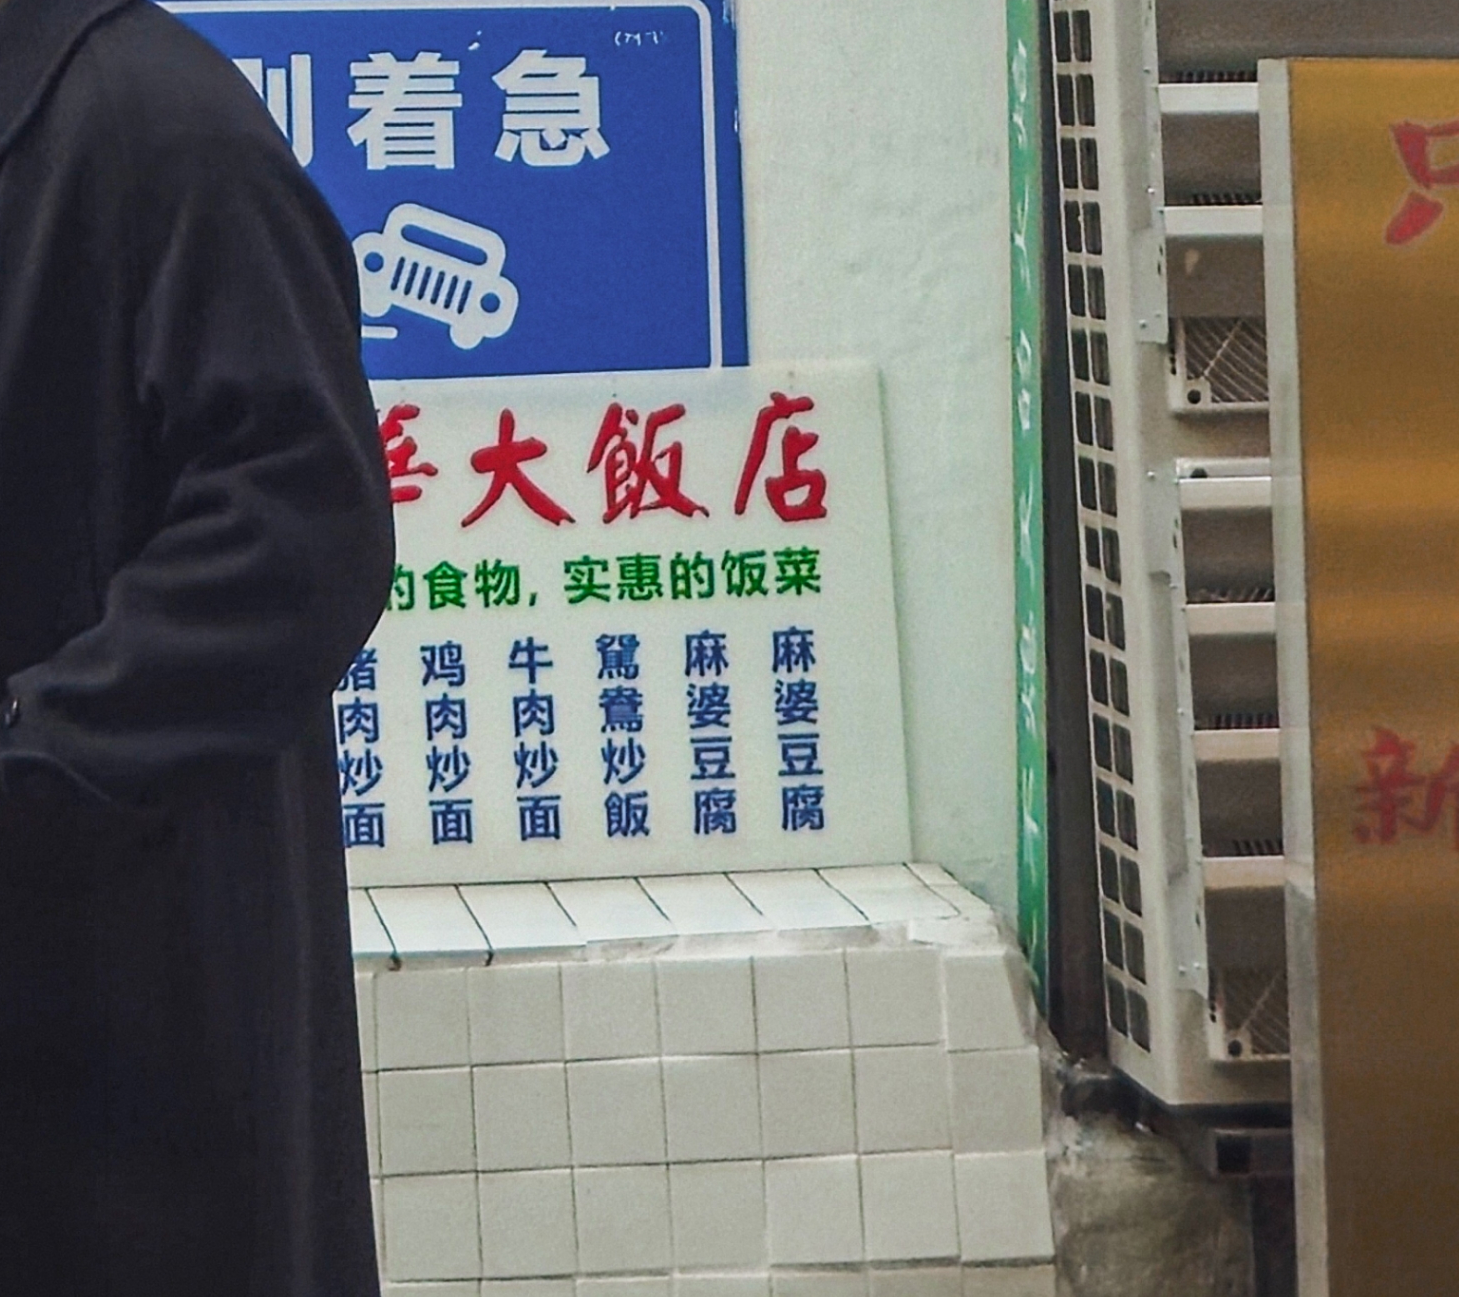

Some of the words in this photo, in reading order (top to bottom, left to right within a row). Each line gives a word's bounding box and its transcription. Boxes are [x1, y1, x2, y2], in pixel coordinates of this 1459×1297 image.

[420, 639, 473, 845] 鸡肉炒面
[509, 636, 561, 841] 牛肉炒面
[685, 629, 737, 835] 麻婆豆腐
[772, 625, 825, 831] 麻婆豆腐
